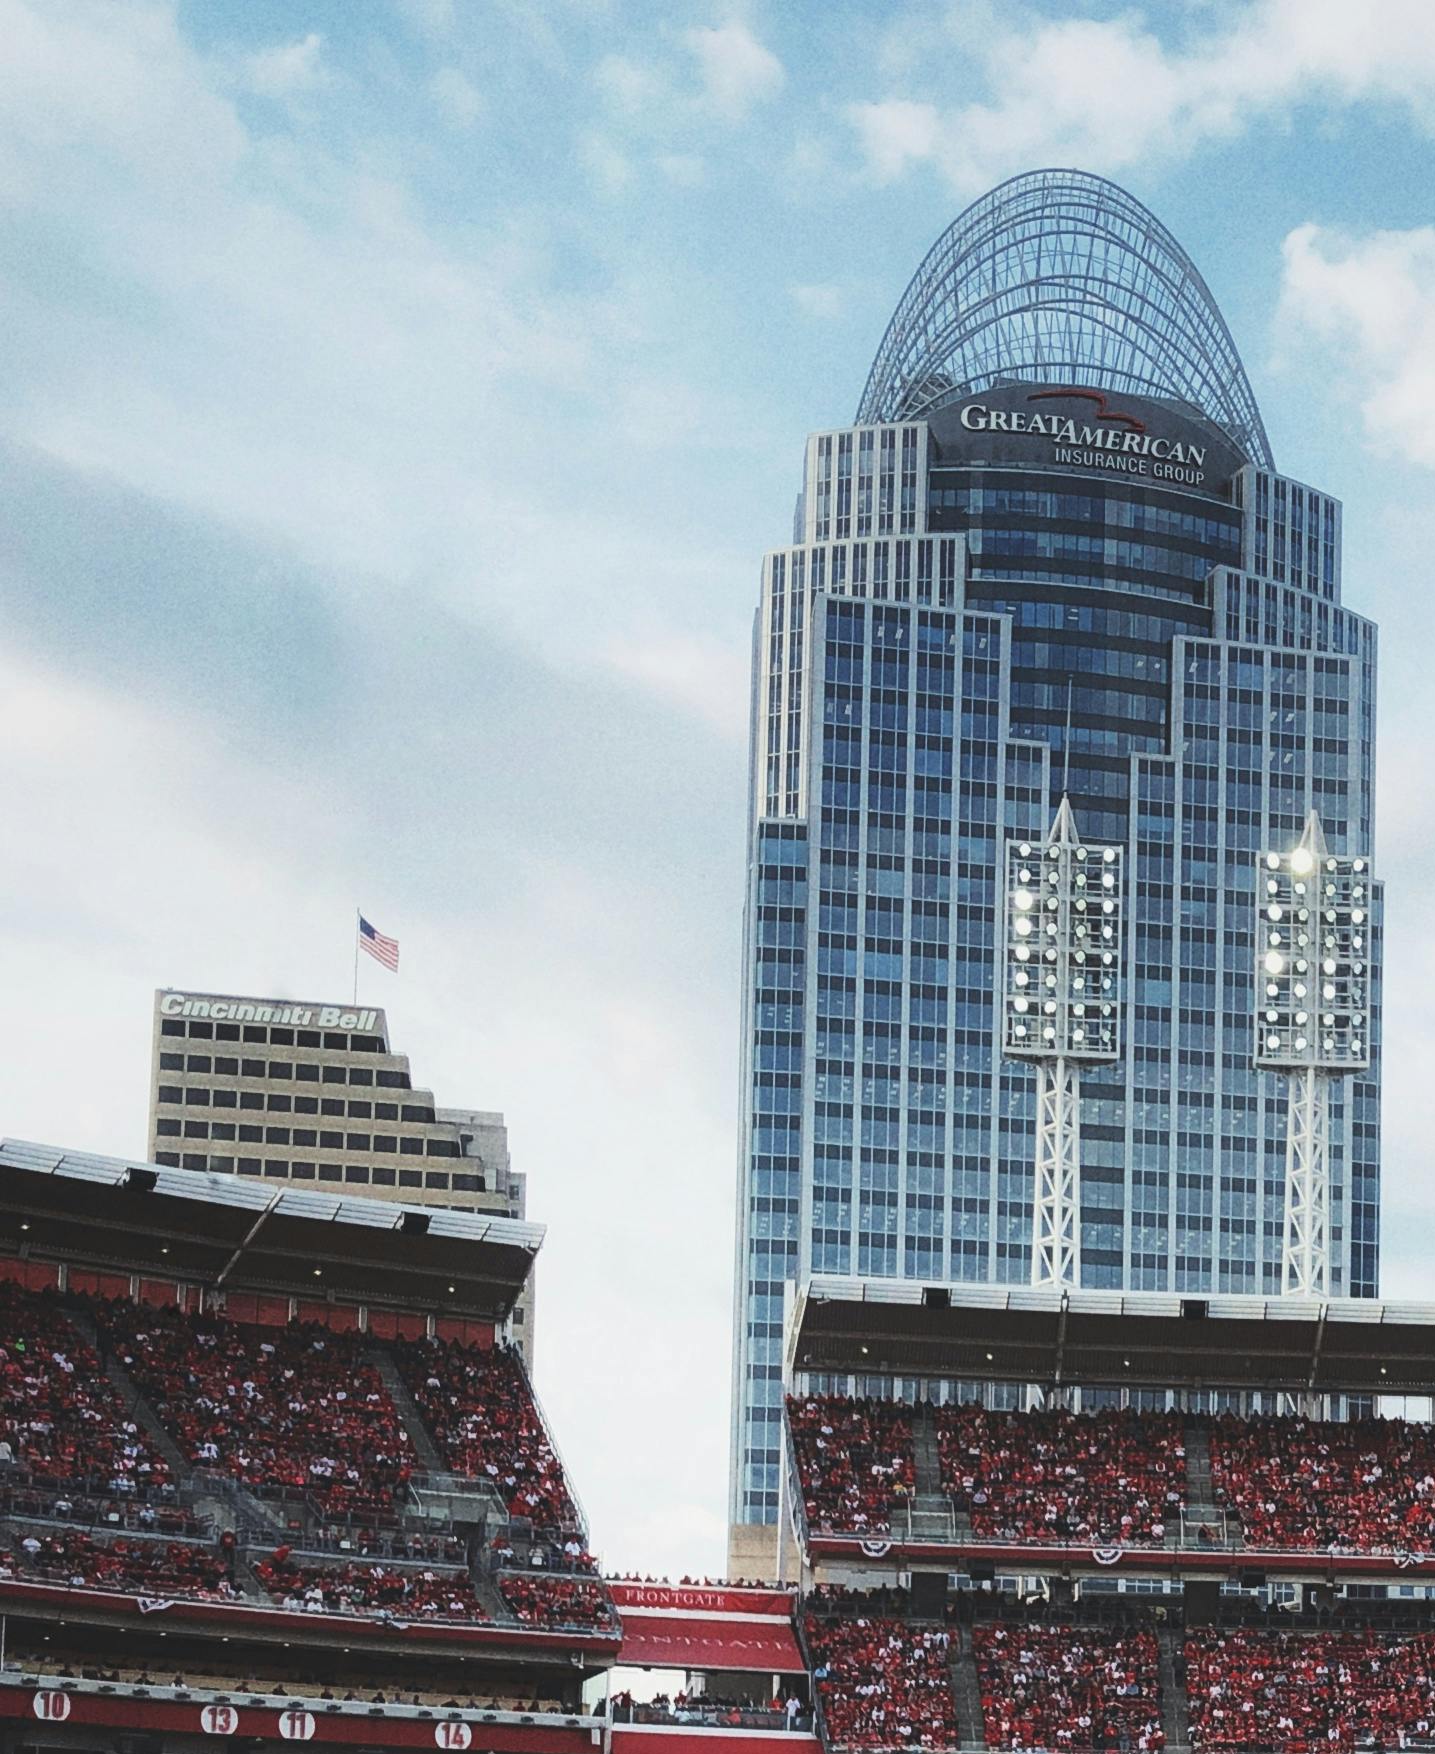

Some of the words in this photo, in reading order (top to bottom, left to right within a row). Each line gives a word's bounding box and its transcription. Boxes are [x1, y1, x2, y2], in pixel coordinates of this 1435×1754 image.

[1055, 448, 1147, 475] INSURANCE
[1153, 463, 1205, 486] GROUP
[318, 1007, 377, 1031] Bell
[626, 1589, 726, 1607] FRONTGATE
[40, 1693, 65, 1719] 10
[207, 1706, 231, 1732] 13
[286, 1713, 308, 1739] 11
[441, 1722, 466, 1748] 14
